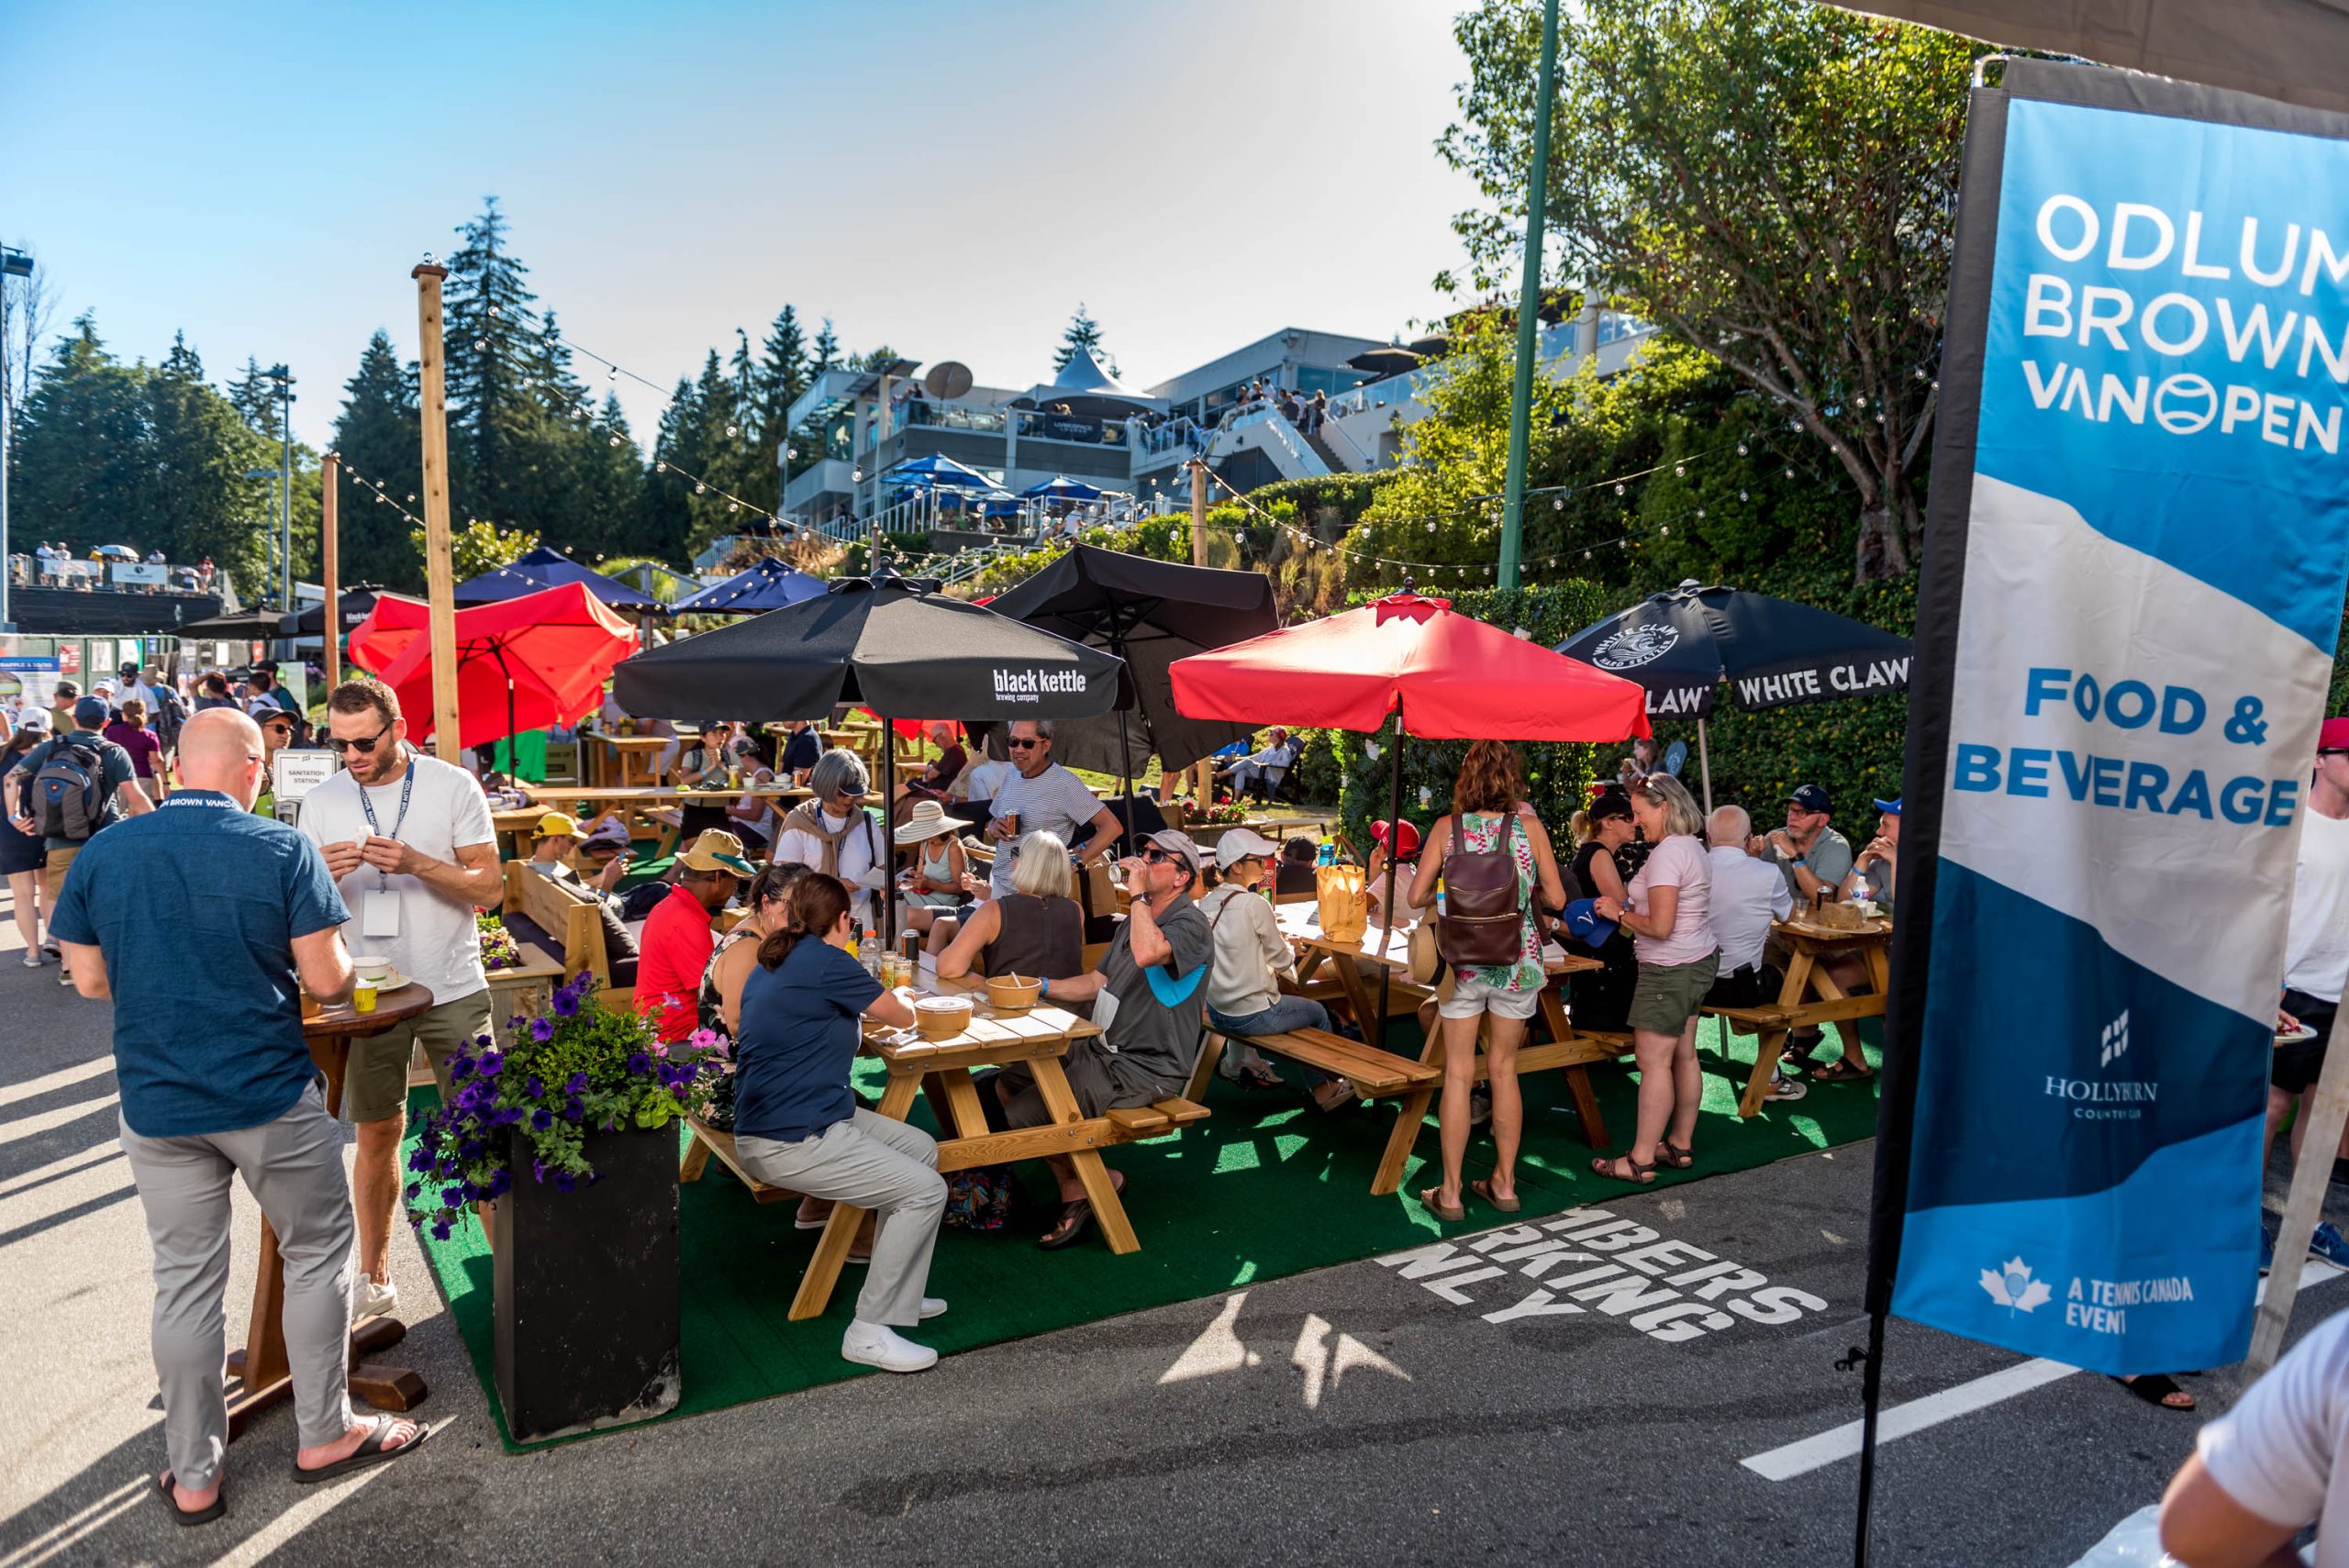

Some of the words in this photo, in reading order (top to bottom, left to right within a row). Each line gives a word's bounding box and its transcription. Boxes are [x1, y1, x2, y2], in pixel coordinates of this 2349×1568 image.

[2023, 273, 2349, 384] BROWN
[1593, 628, 1635, 655] WHITE
[1639, 624, 1678, 636] CLAW
[1599, 657, 1624, 667] HARD
[1630, 640, 1672, 665] SELTZER
[993, 669, 1038, 692] black
[1040, 669, 1085, 692] kettle
[1739, 669, 1821, 705] WHITE
[1830, 657, 1909, 691] CLAW
[996, 693, 1016, 703] brewing
[1017, 694, 1039, 703] company
[2024, 668, 2207, 735] FOOD
[2223, 695, 2269, 746] &
[402, 780, 411, 801] ODLUM
[1953, 743, 2299, 828] BEVERAGE
[170, 798, 203, 806] BROWN
[2067, 1276, 2083, 1301] A
[2090, 1279, 2141, 1307] TENNIS
[2143, 1276, 2193, 1303] CANADA
[2065, 1303, 2126, 1334] EVENT
